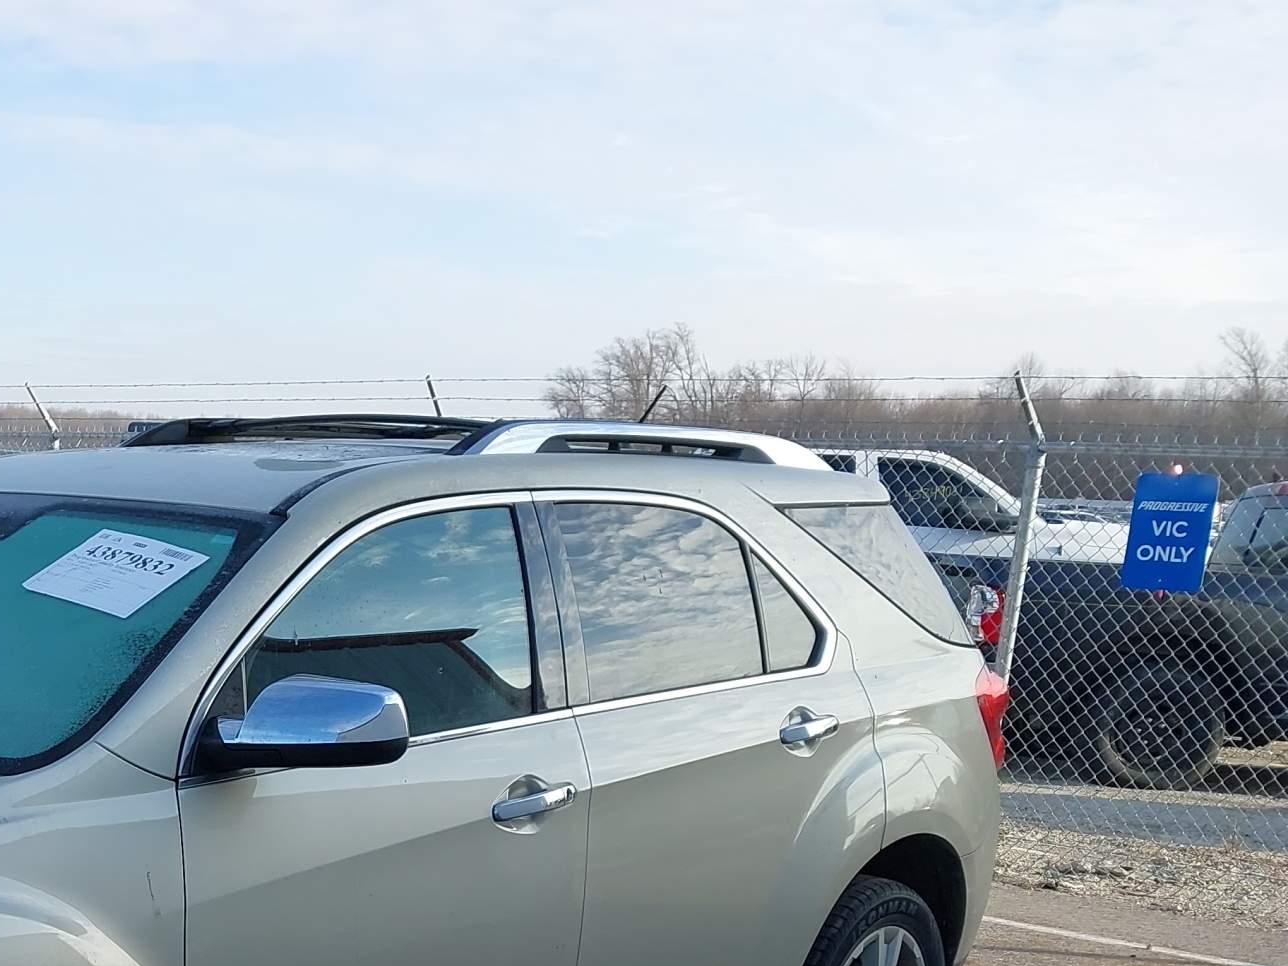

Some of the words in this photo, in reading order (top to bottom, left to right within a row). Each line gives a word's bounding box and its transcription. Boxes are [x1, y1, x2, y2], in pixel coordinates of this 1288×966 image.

[1137, 500, 1210, 513] PROGRESSIVE
[1152, 519, 1189, 538] VIC
[86, 544, 175, 576] 43879832
[1136, 544, 1195, 563] ONLY
[852, 900, 918, 938] IRONMAN
